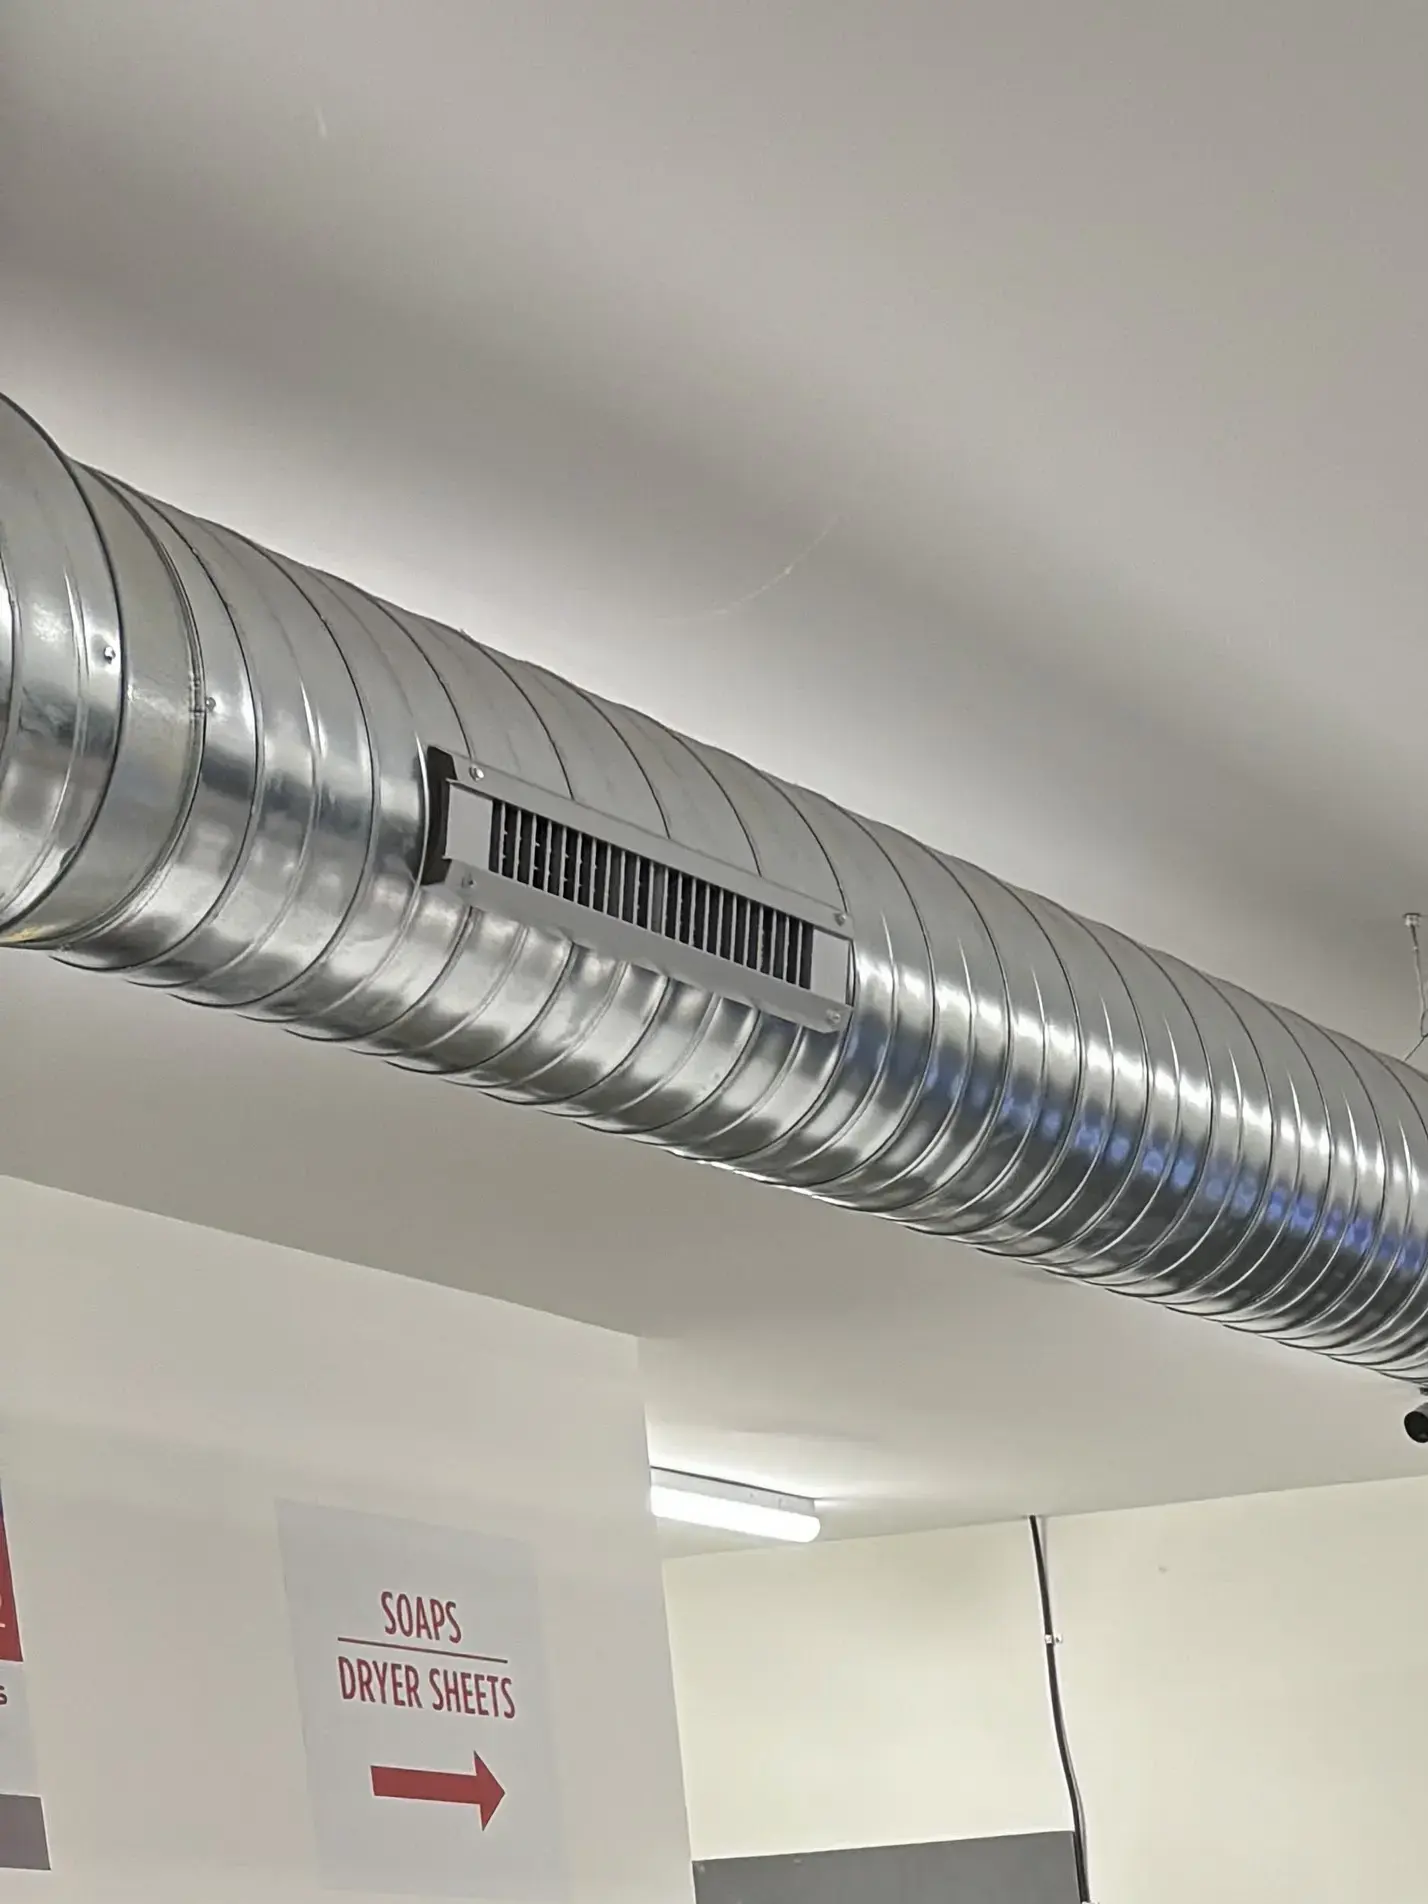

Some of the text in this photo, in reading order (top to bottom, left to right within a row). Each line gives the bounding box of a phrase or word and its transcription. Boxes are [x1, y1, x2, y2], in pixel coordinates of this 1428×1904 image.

[381, 1590, 462, 1644] SOAPS
[337, 1655, 516, 1719] DRYER SHEETS
